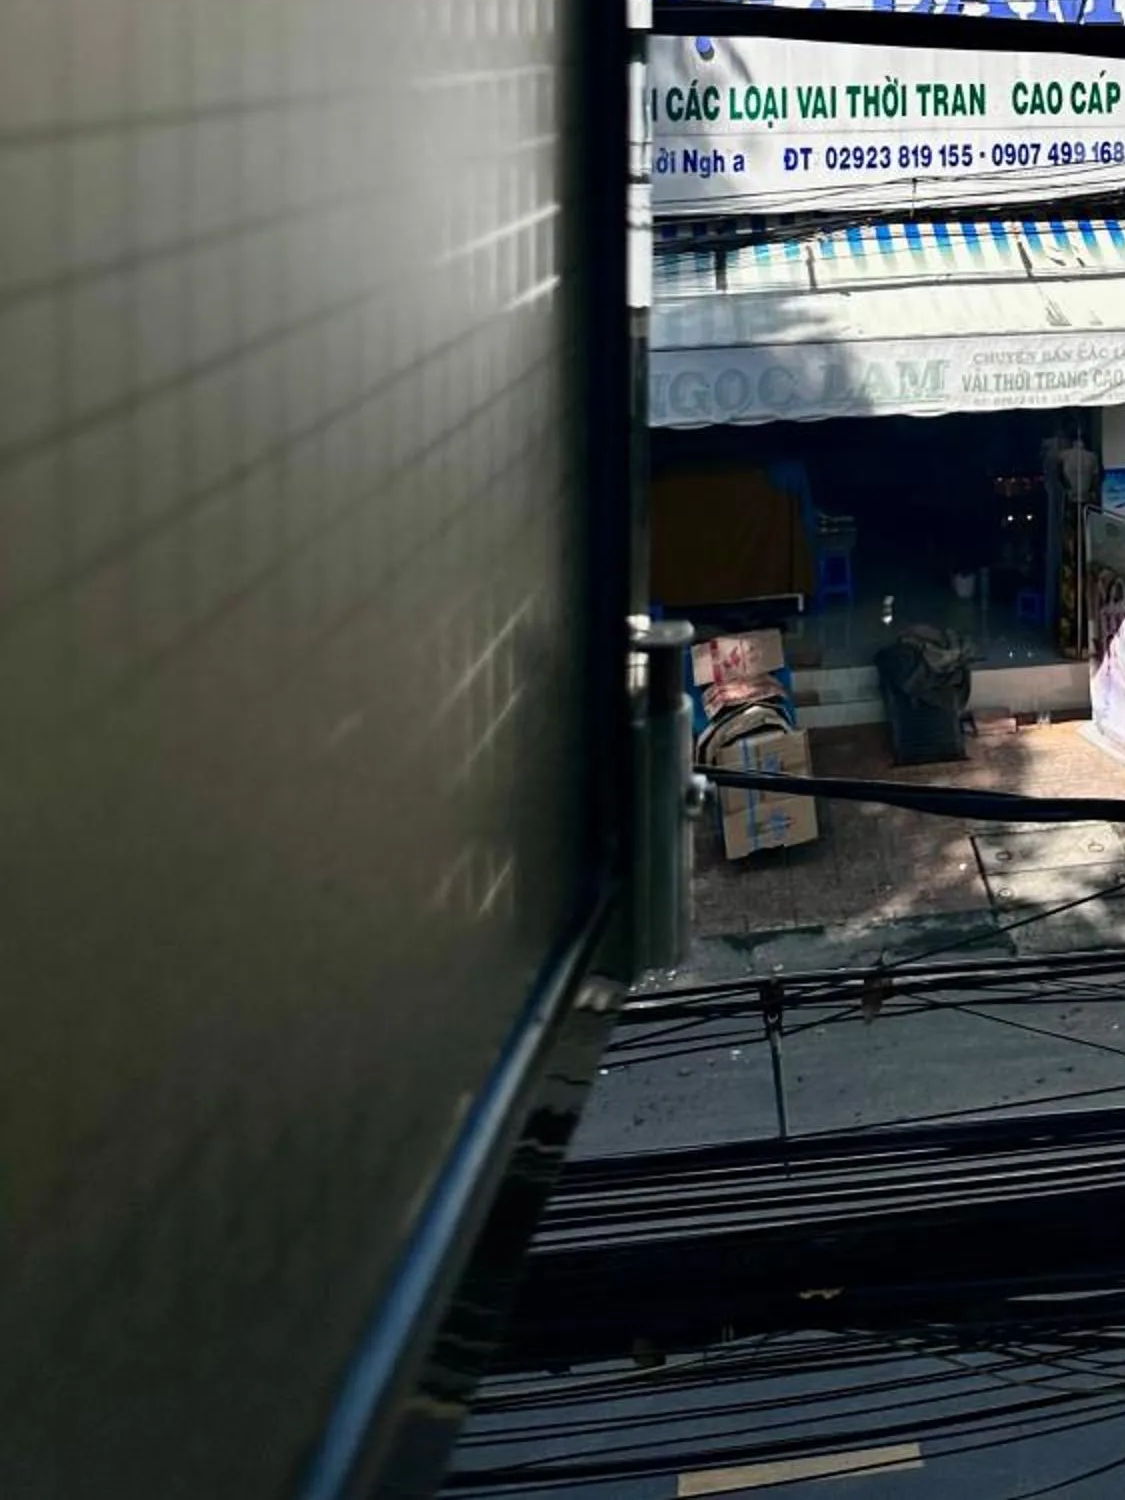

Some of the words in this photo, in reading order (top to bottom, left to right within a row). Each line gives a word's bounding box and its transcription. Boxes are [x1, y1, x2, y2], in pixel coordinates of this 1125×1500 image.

[666, 80, 720, 121] CÁC
[729, 86, 788, 129] LOẠI
[846, 75, 908, 119] THỜI
[916, 83, 986, 117] TRAN
[1011, 81, 1064, 116] CAO
[783, 147, 813, 172] ĐT
[825, 145, 892, 170] 02923
[898, 144, 933, 169] 819
[938, 143, 974, 168] 155
[991, 142, 1043, 168] 0907
[1047, 141, 1087, 166] 499
[1091, 140, 1125, 164] 168
[1035, 370, 1090, 391] TRANG
